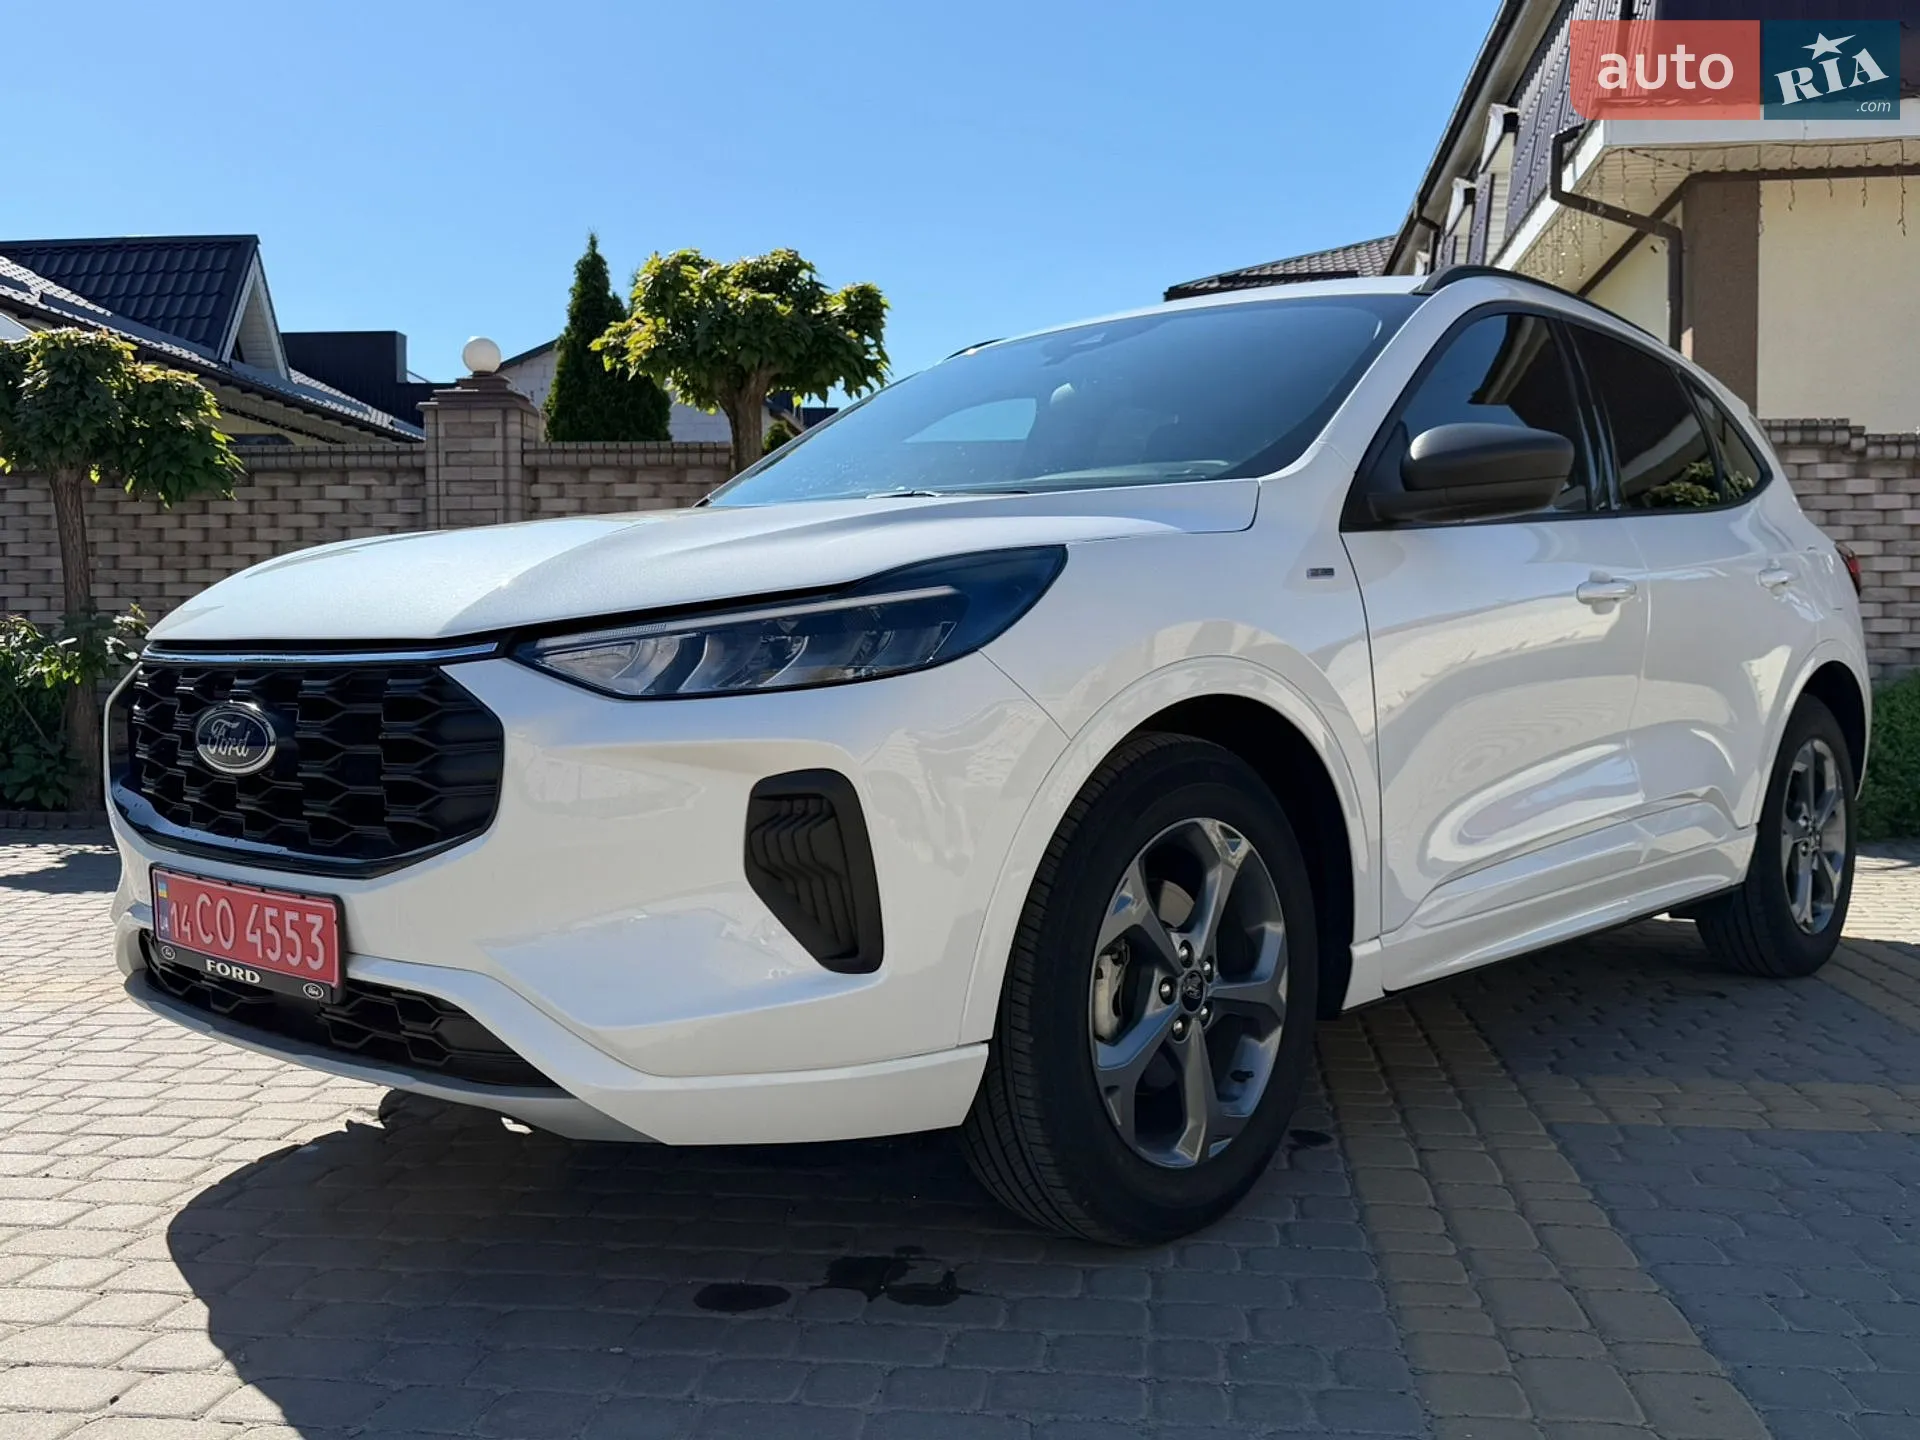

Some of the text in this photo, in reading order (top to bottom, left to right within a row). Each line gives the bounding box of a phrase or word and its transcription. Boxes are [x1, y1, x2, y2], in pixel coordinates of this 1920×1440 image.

[206, 718, 250, 758] Ford
[246, 903, 325, 971] 4553
[206, 958, 260, 984] FORD
